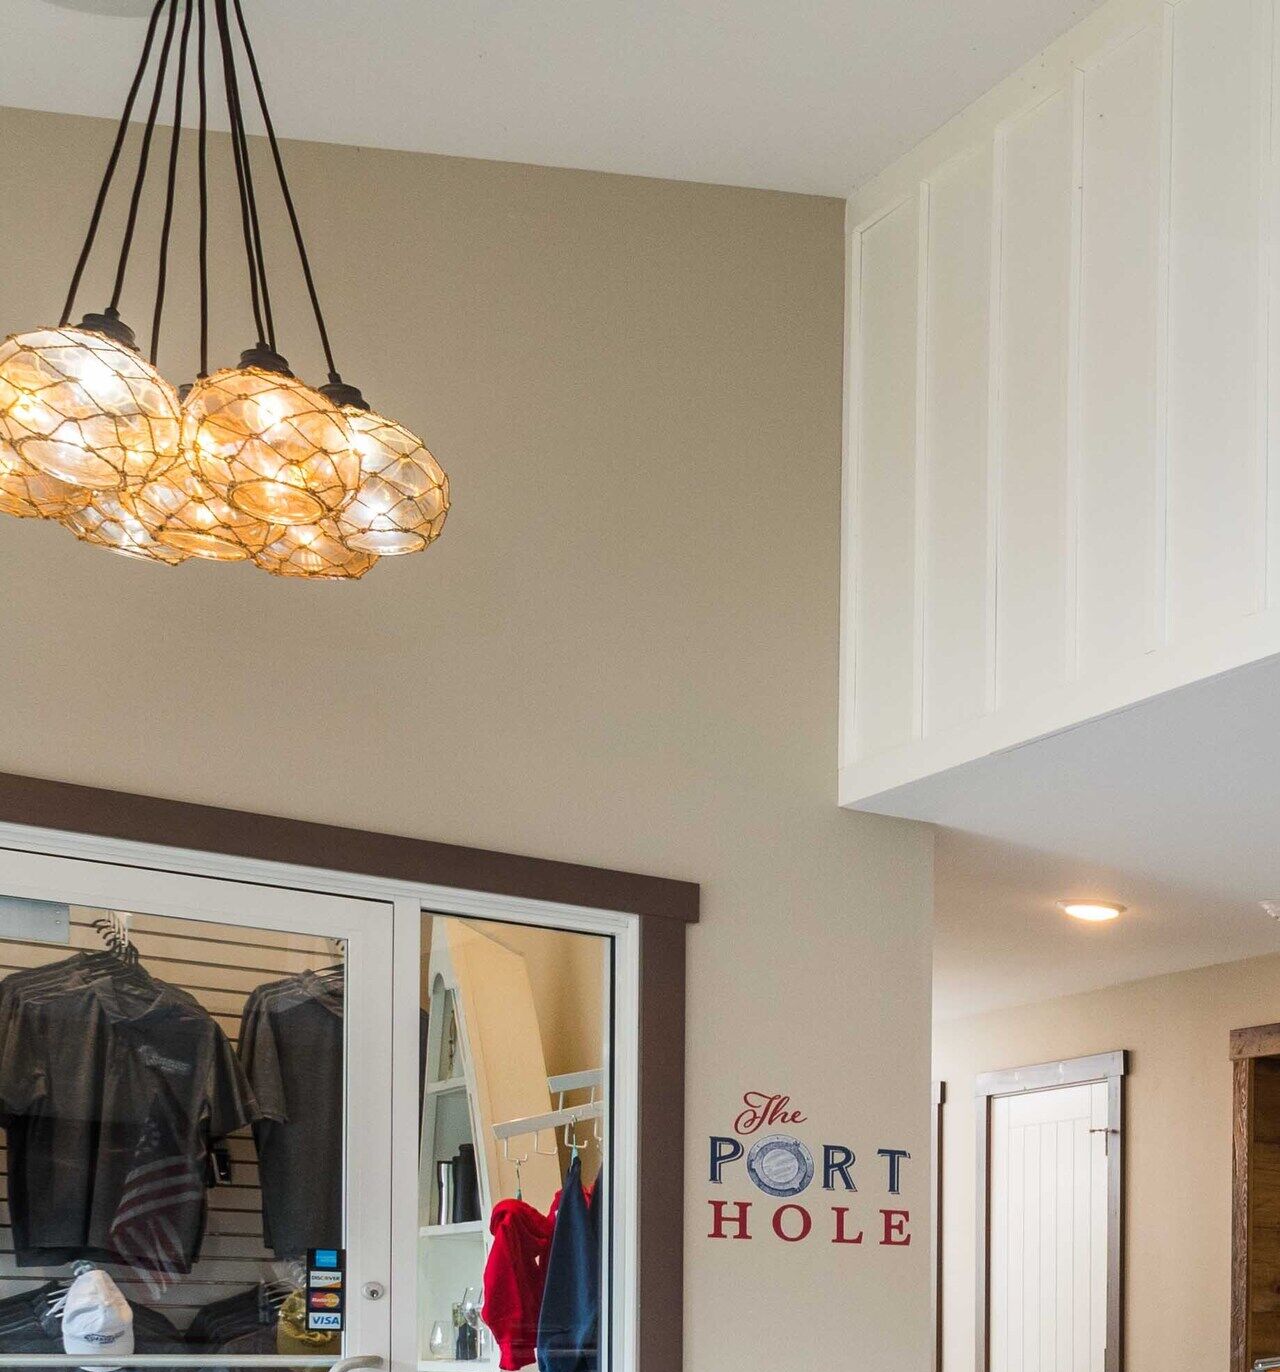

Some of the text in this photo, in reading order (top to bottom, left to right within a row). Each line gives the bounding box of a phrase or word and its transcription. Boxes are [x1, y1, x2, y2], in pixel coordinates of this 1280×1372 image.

[734, 1091, 807, 1135] The
[707, 1200, 912, 1246] HOLE
[312, 1316, 340, 1325] VISA
